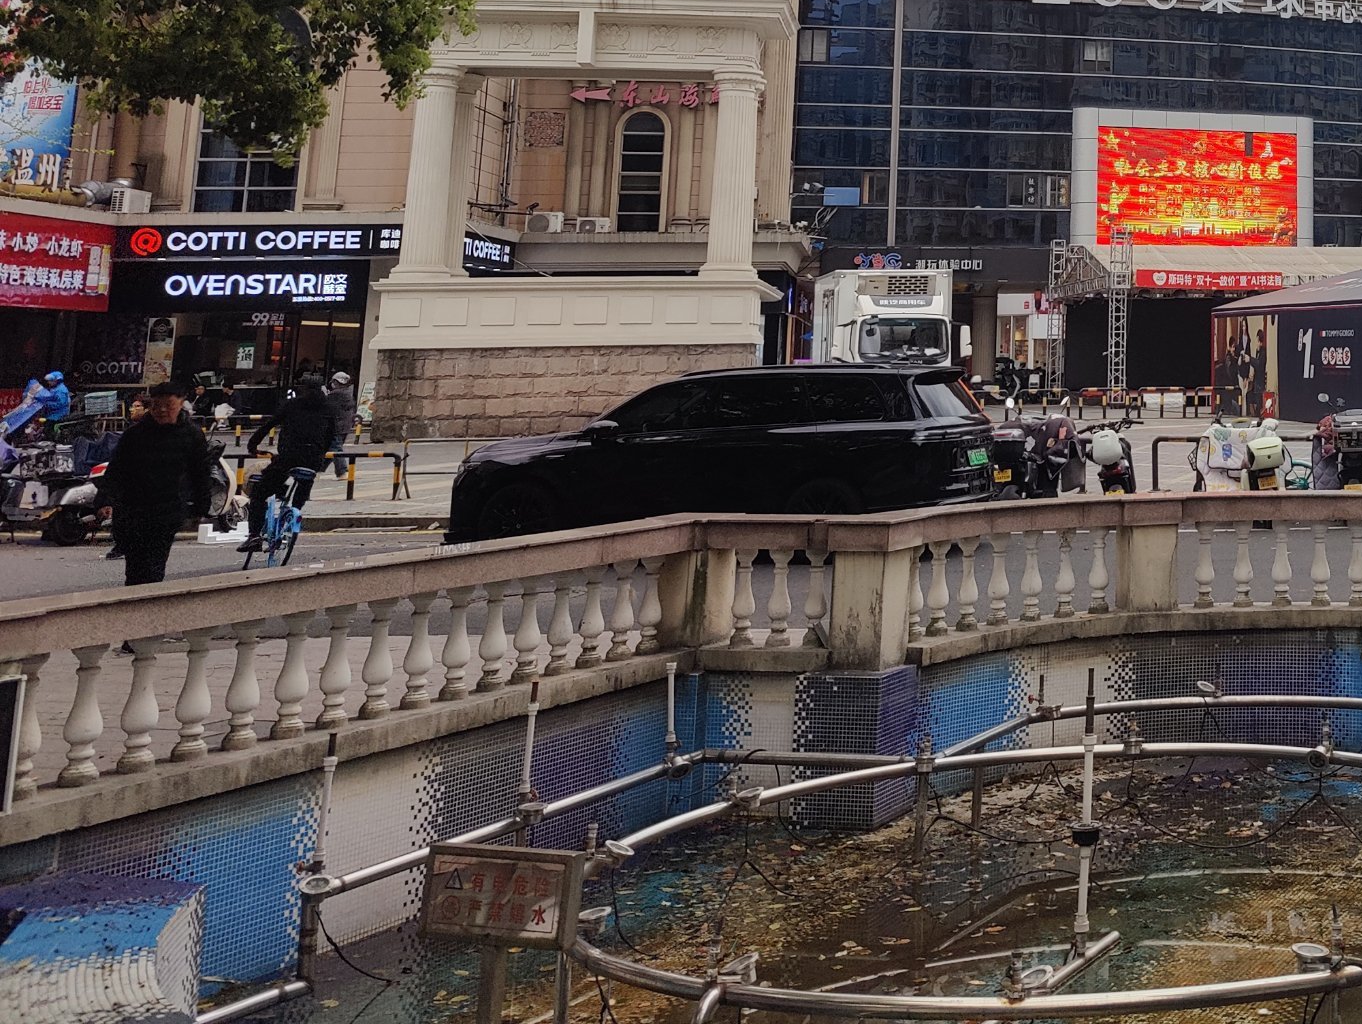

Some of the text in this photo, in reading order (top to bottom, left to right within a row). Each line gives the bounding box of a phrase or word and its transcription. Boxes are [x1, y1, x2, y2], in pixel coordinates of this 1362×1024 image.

[46, 235, 83, 259] 小龙虾
[166, 230, 362, 251] COTTI COFFEE
[473, 240, 501, 261] COFFEE
[164, 273, 317, 296] OVENSTAR
[96, 361, 143, 375] COTTI
